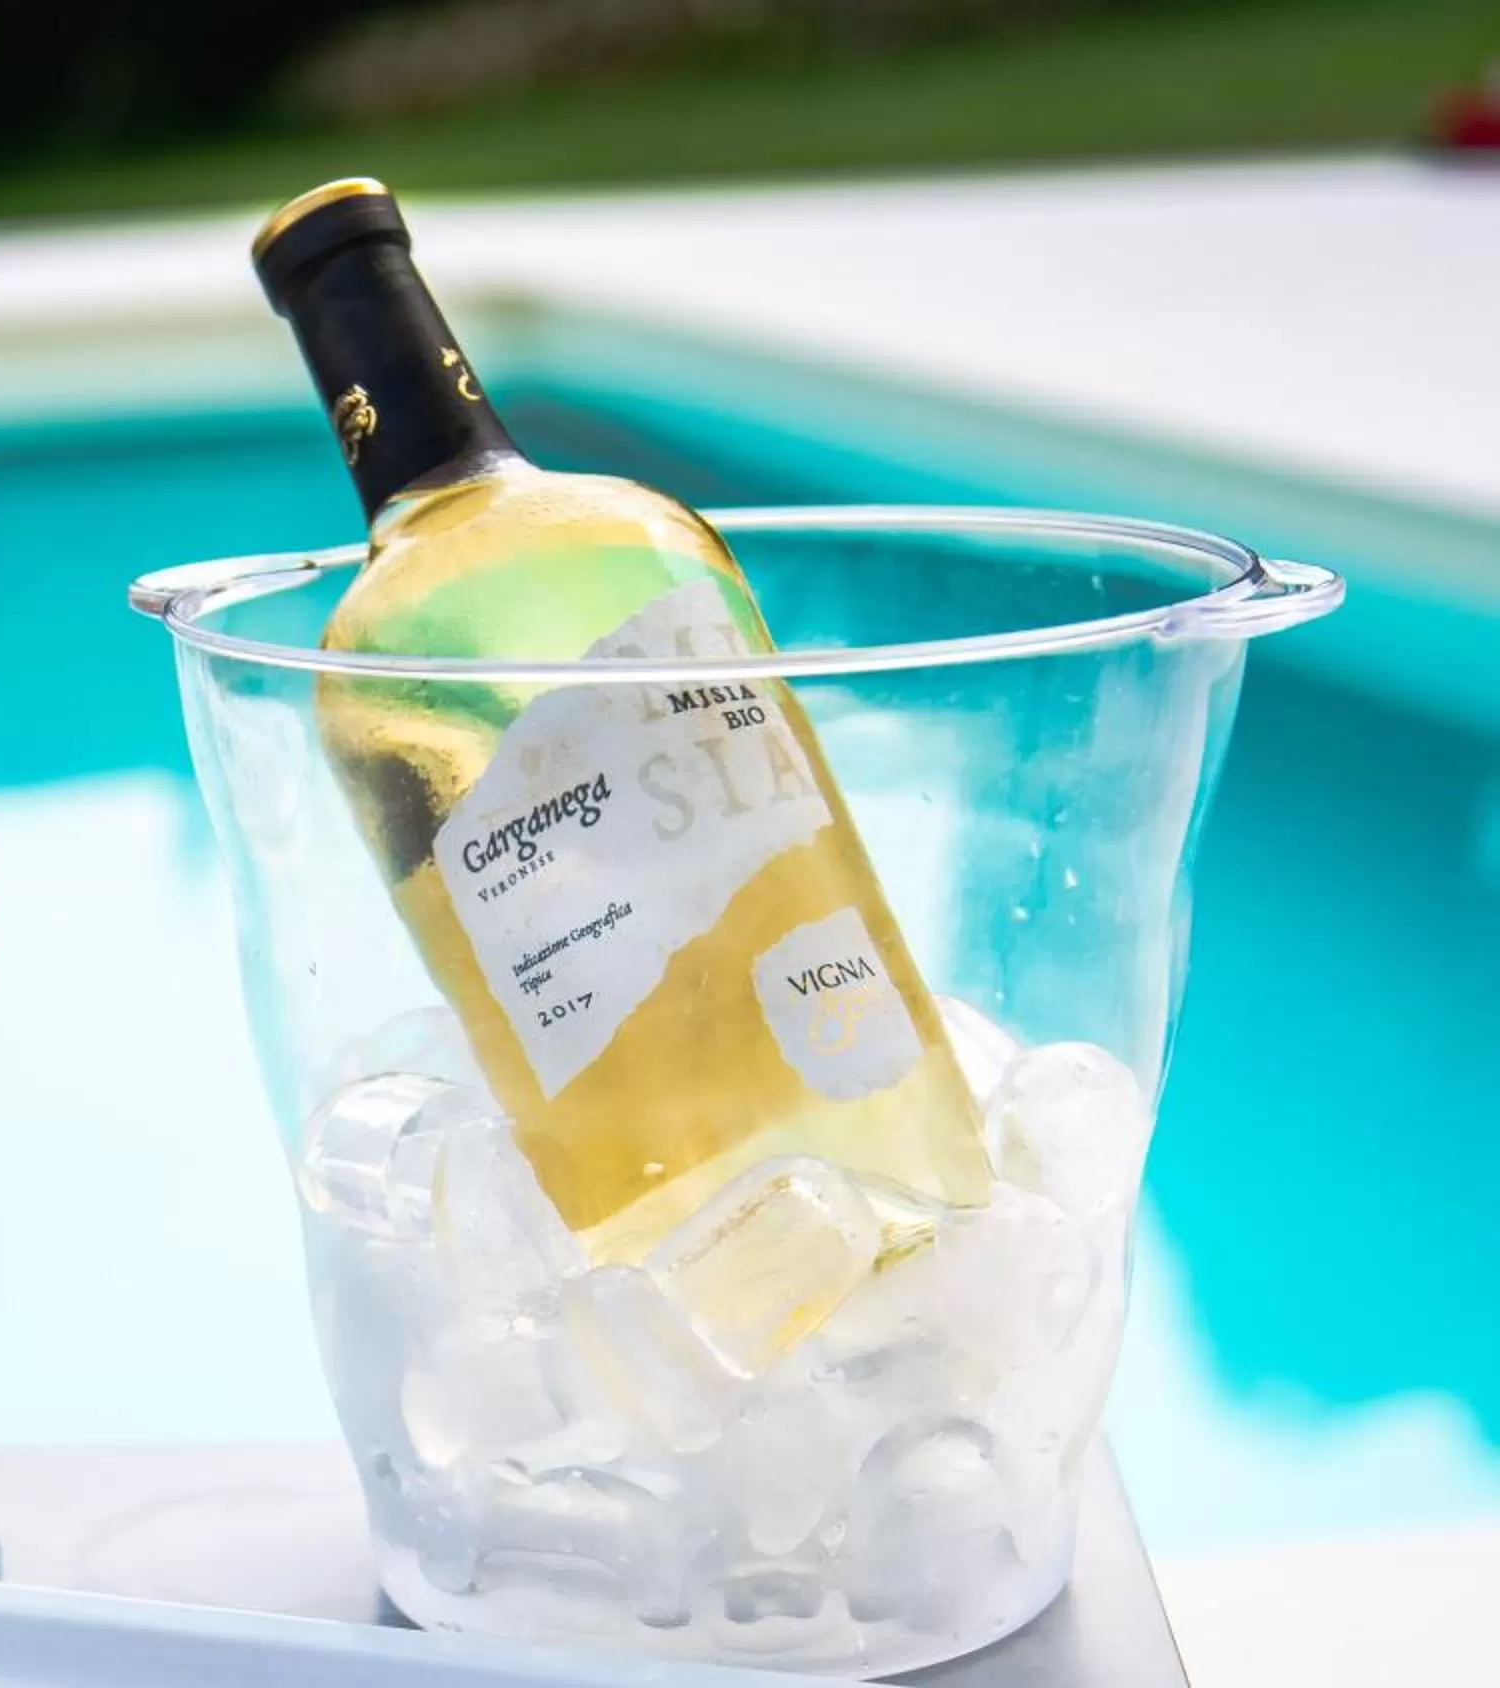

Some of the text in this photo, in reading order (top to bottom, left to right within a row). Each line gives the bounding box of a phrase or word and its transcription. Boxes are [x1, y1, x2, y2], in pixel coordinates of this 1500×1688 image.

[723, 706, 765, 730] BIO
[463, 772, 612, 873] Garganega
[512, 902, 632, 977] Indicazione Geografica
[787, 955, 876, 996] VIGNA
[537, 991, 593, 1028] 2017
